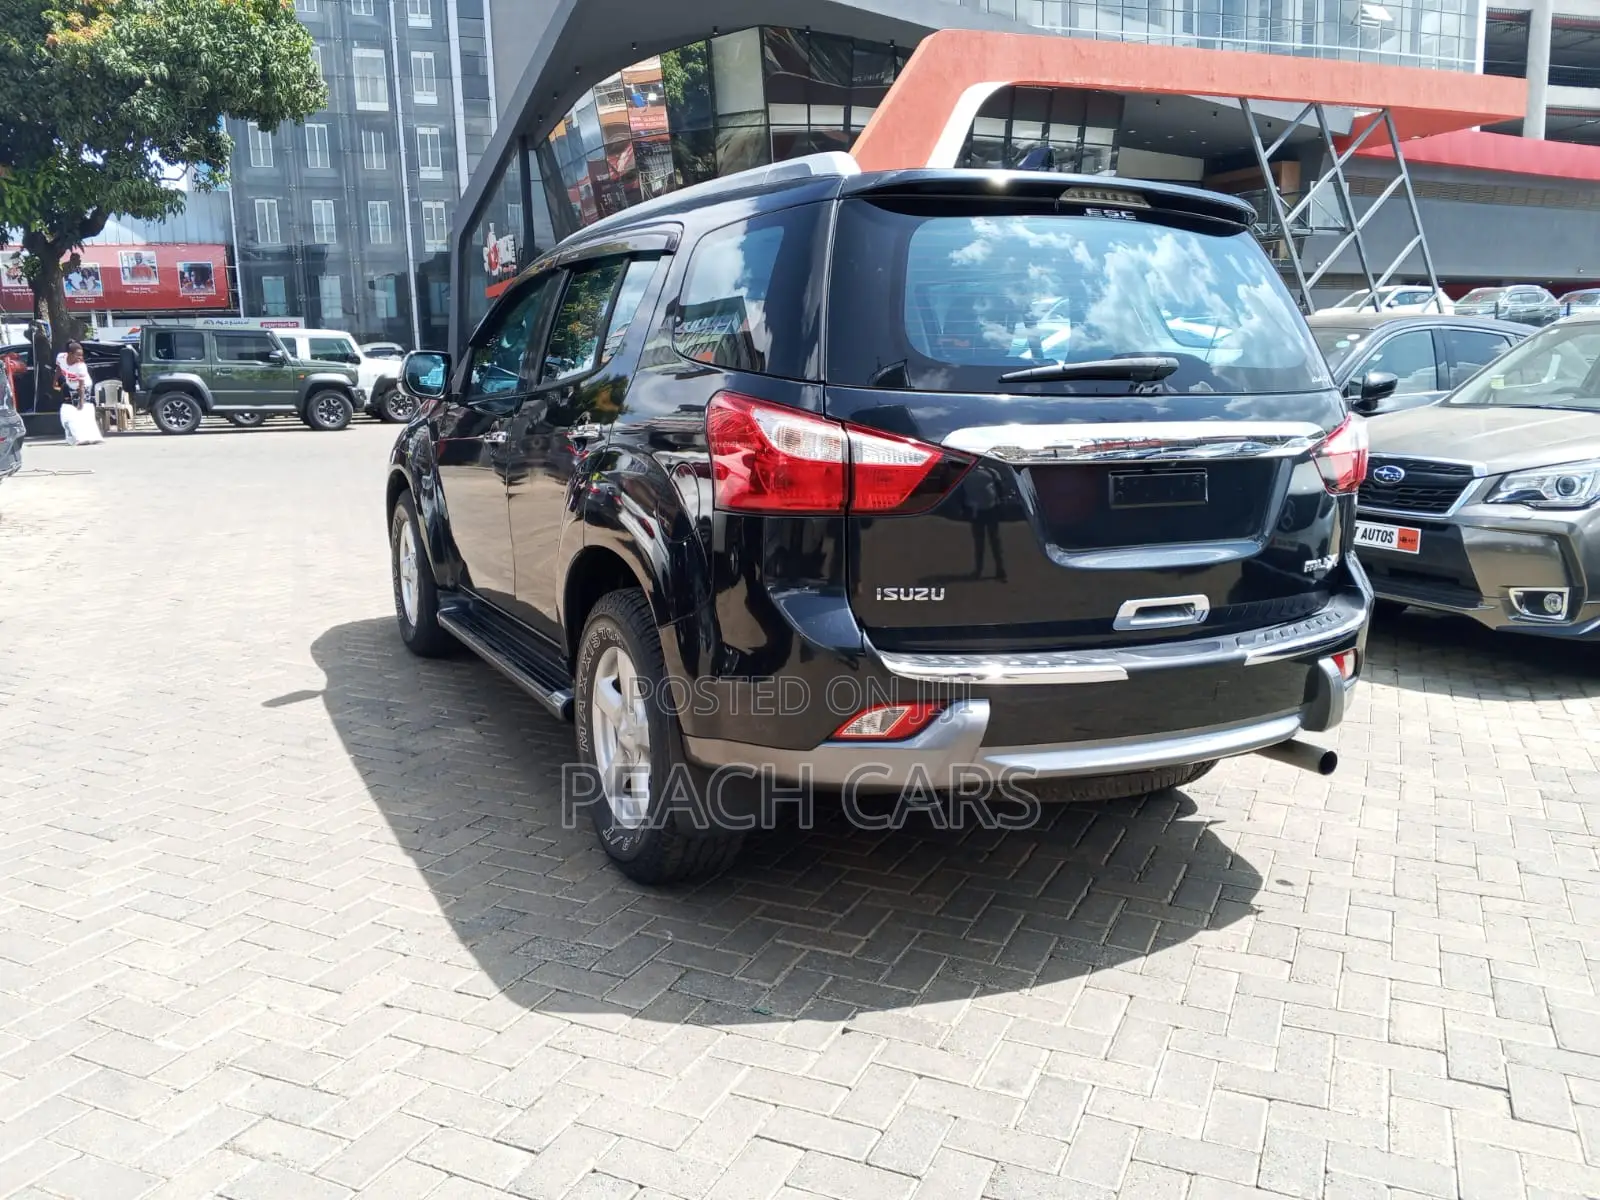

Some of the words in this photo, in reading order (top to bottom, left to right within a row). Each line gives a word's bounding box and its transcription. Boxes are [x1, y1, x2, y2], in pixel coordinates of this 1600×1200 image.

[1361, 527, 1394, 544] AUTOS
[876, 587, 945, 601] ISUZU
[577, 631, 601, 752] MAXXIS
